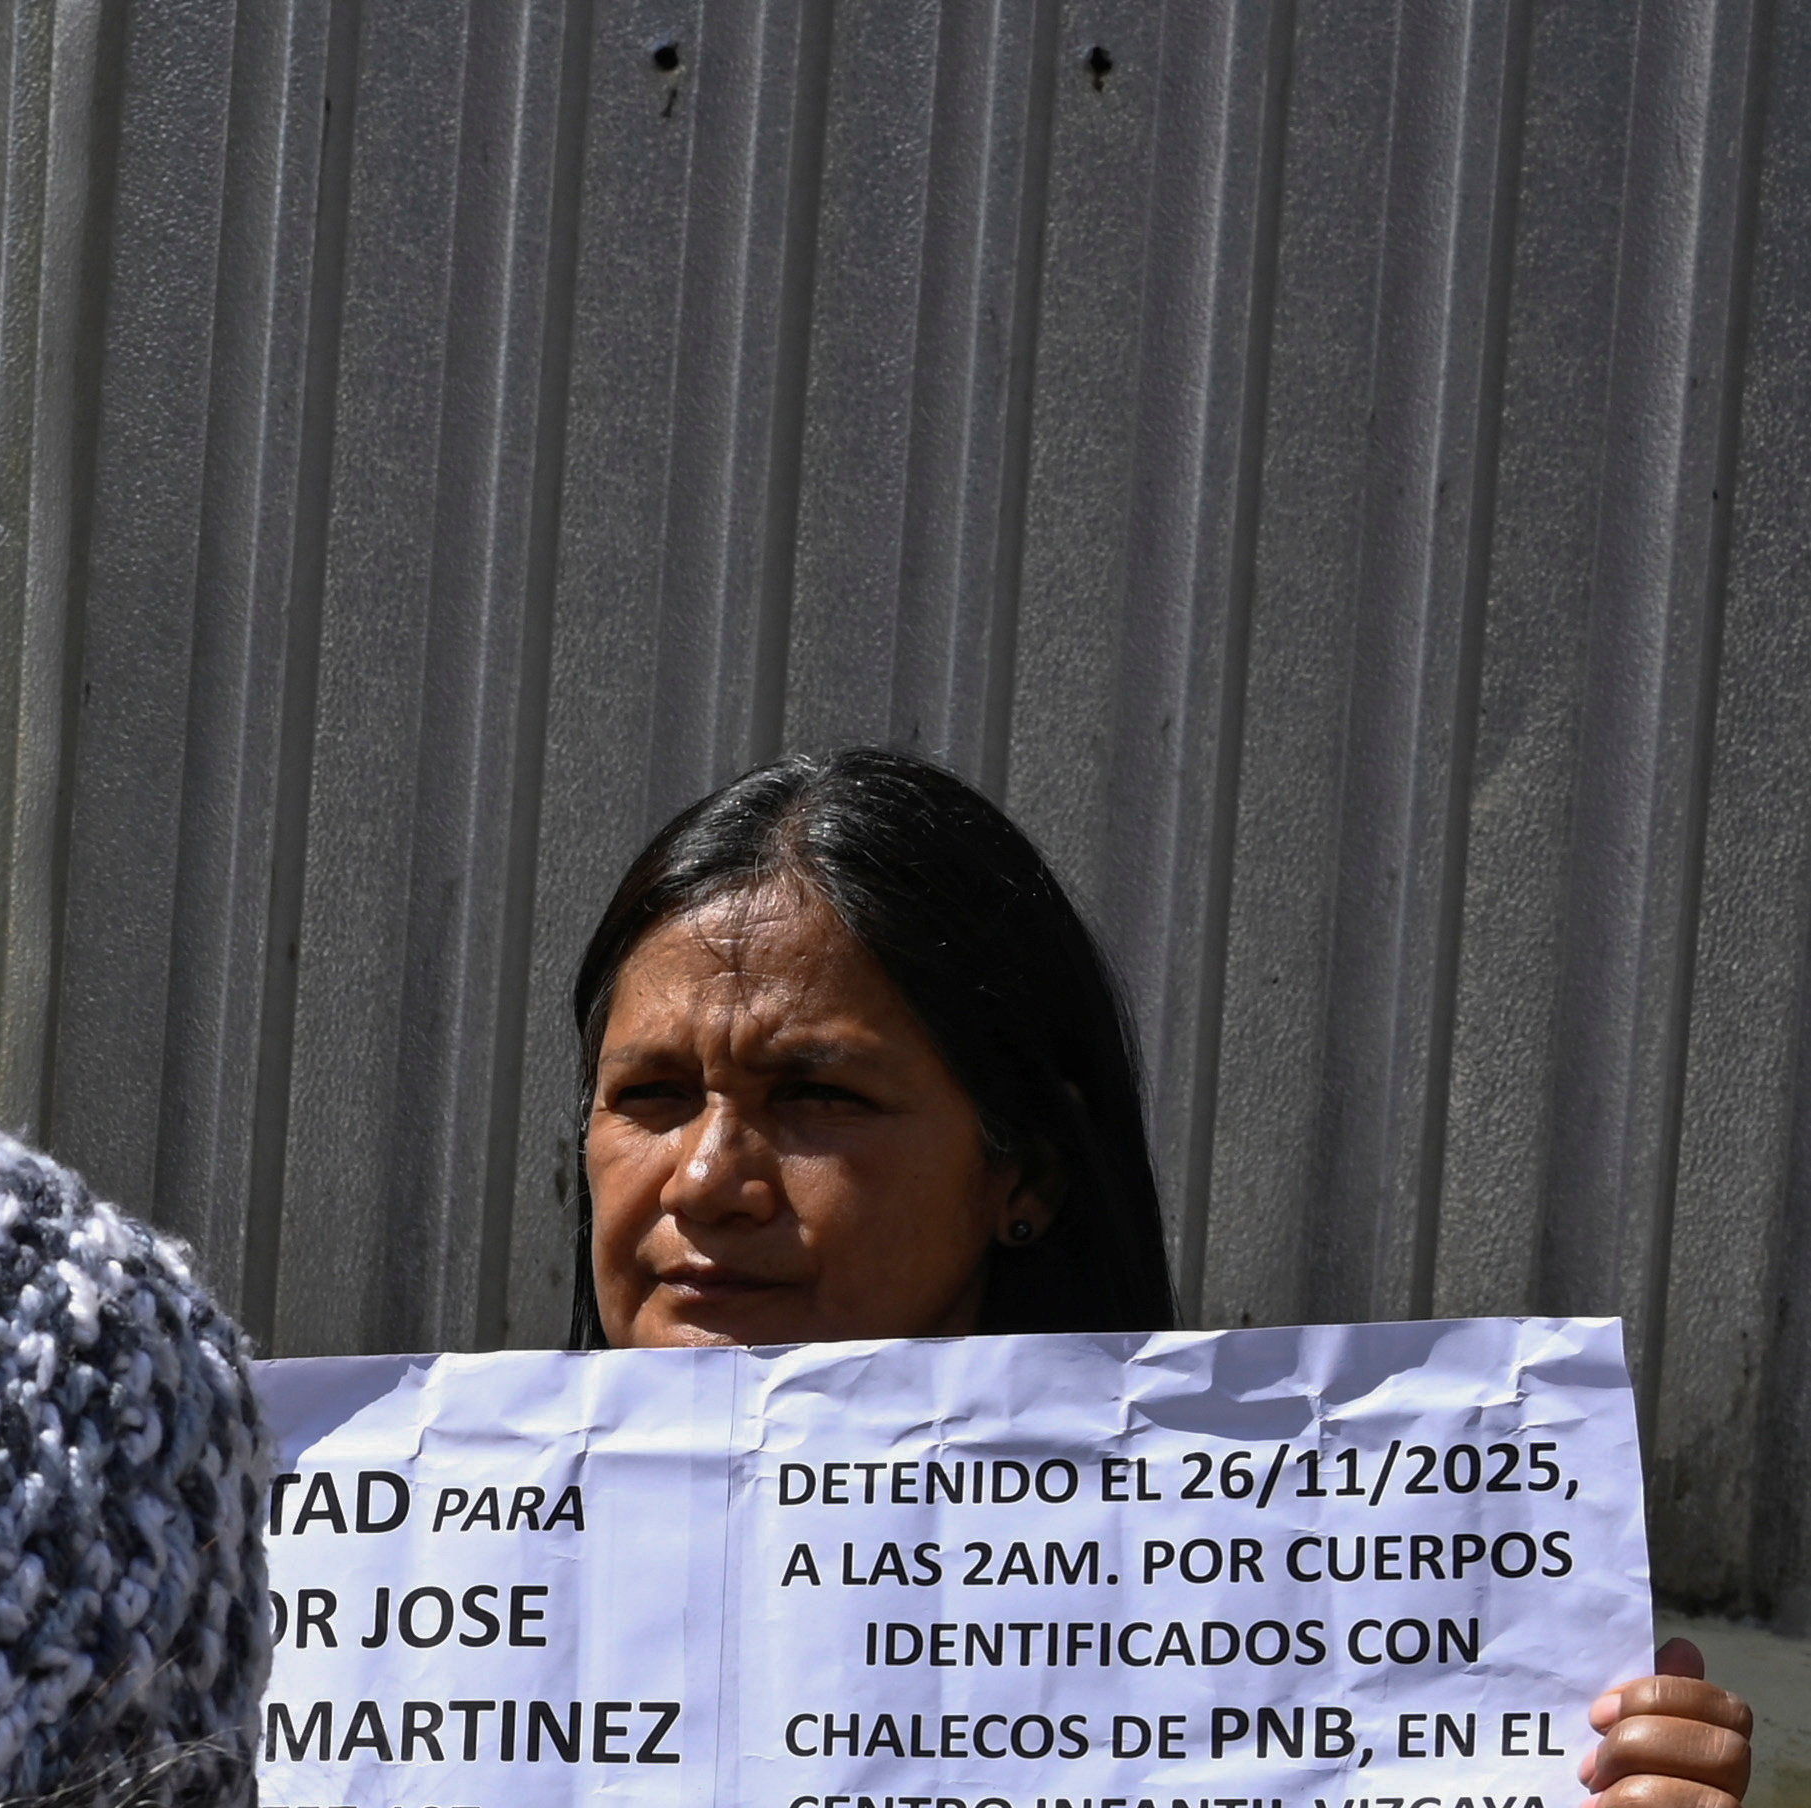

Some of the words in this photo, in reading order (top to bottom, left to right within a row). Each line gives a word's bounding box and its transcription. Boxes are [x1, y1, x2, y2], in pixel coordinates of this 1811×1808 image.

[780, 1459, 1079, 1505] DETENIDO
[1100, 1457, 1162, 1503] EL
[1181, 1441, 1579, 1508] 26/11/2025,
[433, 1485, 585, 1532] PARA
[781, 1543, 821, 1587] A
[843, 1542, 943, 1586] LAS
[962, 1541, 1119, 1586] 2AM.
[1143, 1537, 1265, 1584] POR
[1285, 1531, 1573, 1583] CUERPOS
[362, 1585, 549, 1648] JOSE
[866, 1619, 1327, 1667] IDENTIFICADOS
[1347, 1617, 1480, 1666] CON
[265, 1701, 681, 1764] MARTINEZ
[785, 1713, 1090, 1760] CHALECOS
[1111, 1715, 1187, 1760] DE
[1210, 1706, 1373, 1769] PNB,
[1398, 1713, 1476, 1758] EN
[1501, 1712, 1565, 1756] EL
